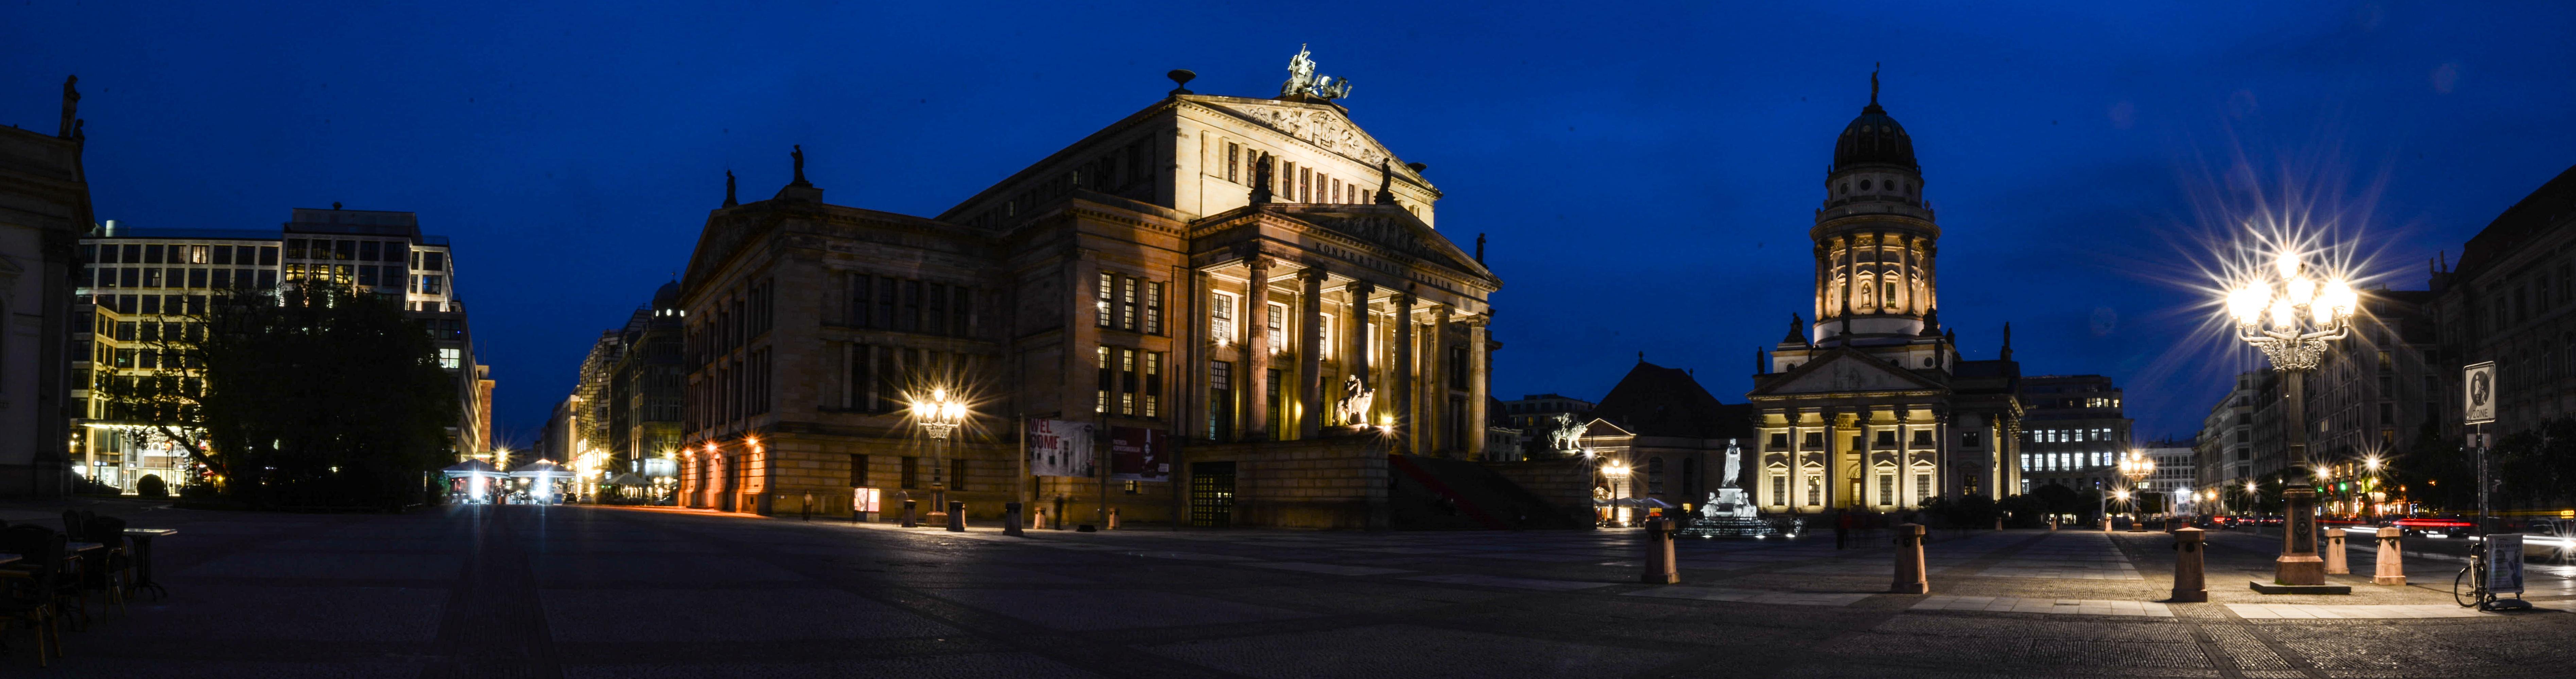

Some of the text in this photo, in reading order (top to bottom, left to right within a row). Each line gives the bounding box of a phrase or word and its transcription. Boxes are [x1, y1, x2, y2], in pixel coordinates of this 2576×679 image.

[1316, 242, 1452, 290] KONZERTHAUS BERLIN
[2473, 409, 2488, 418] ZONE
[1030, 418, 1052, 433] WEL
[1031, 434, 1059, 449] COME
